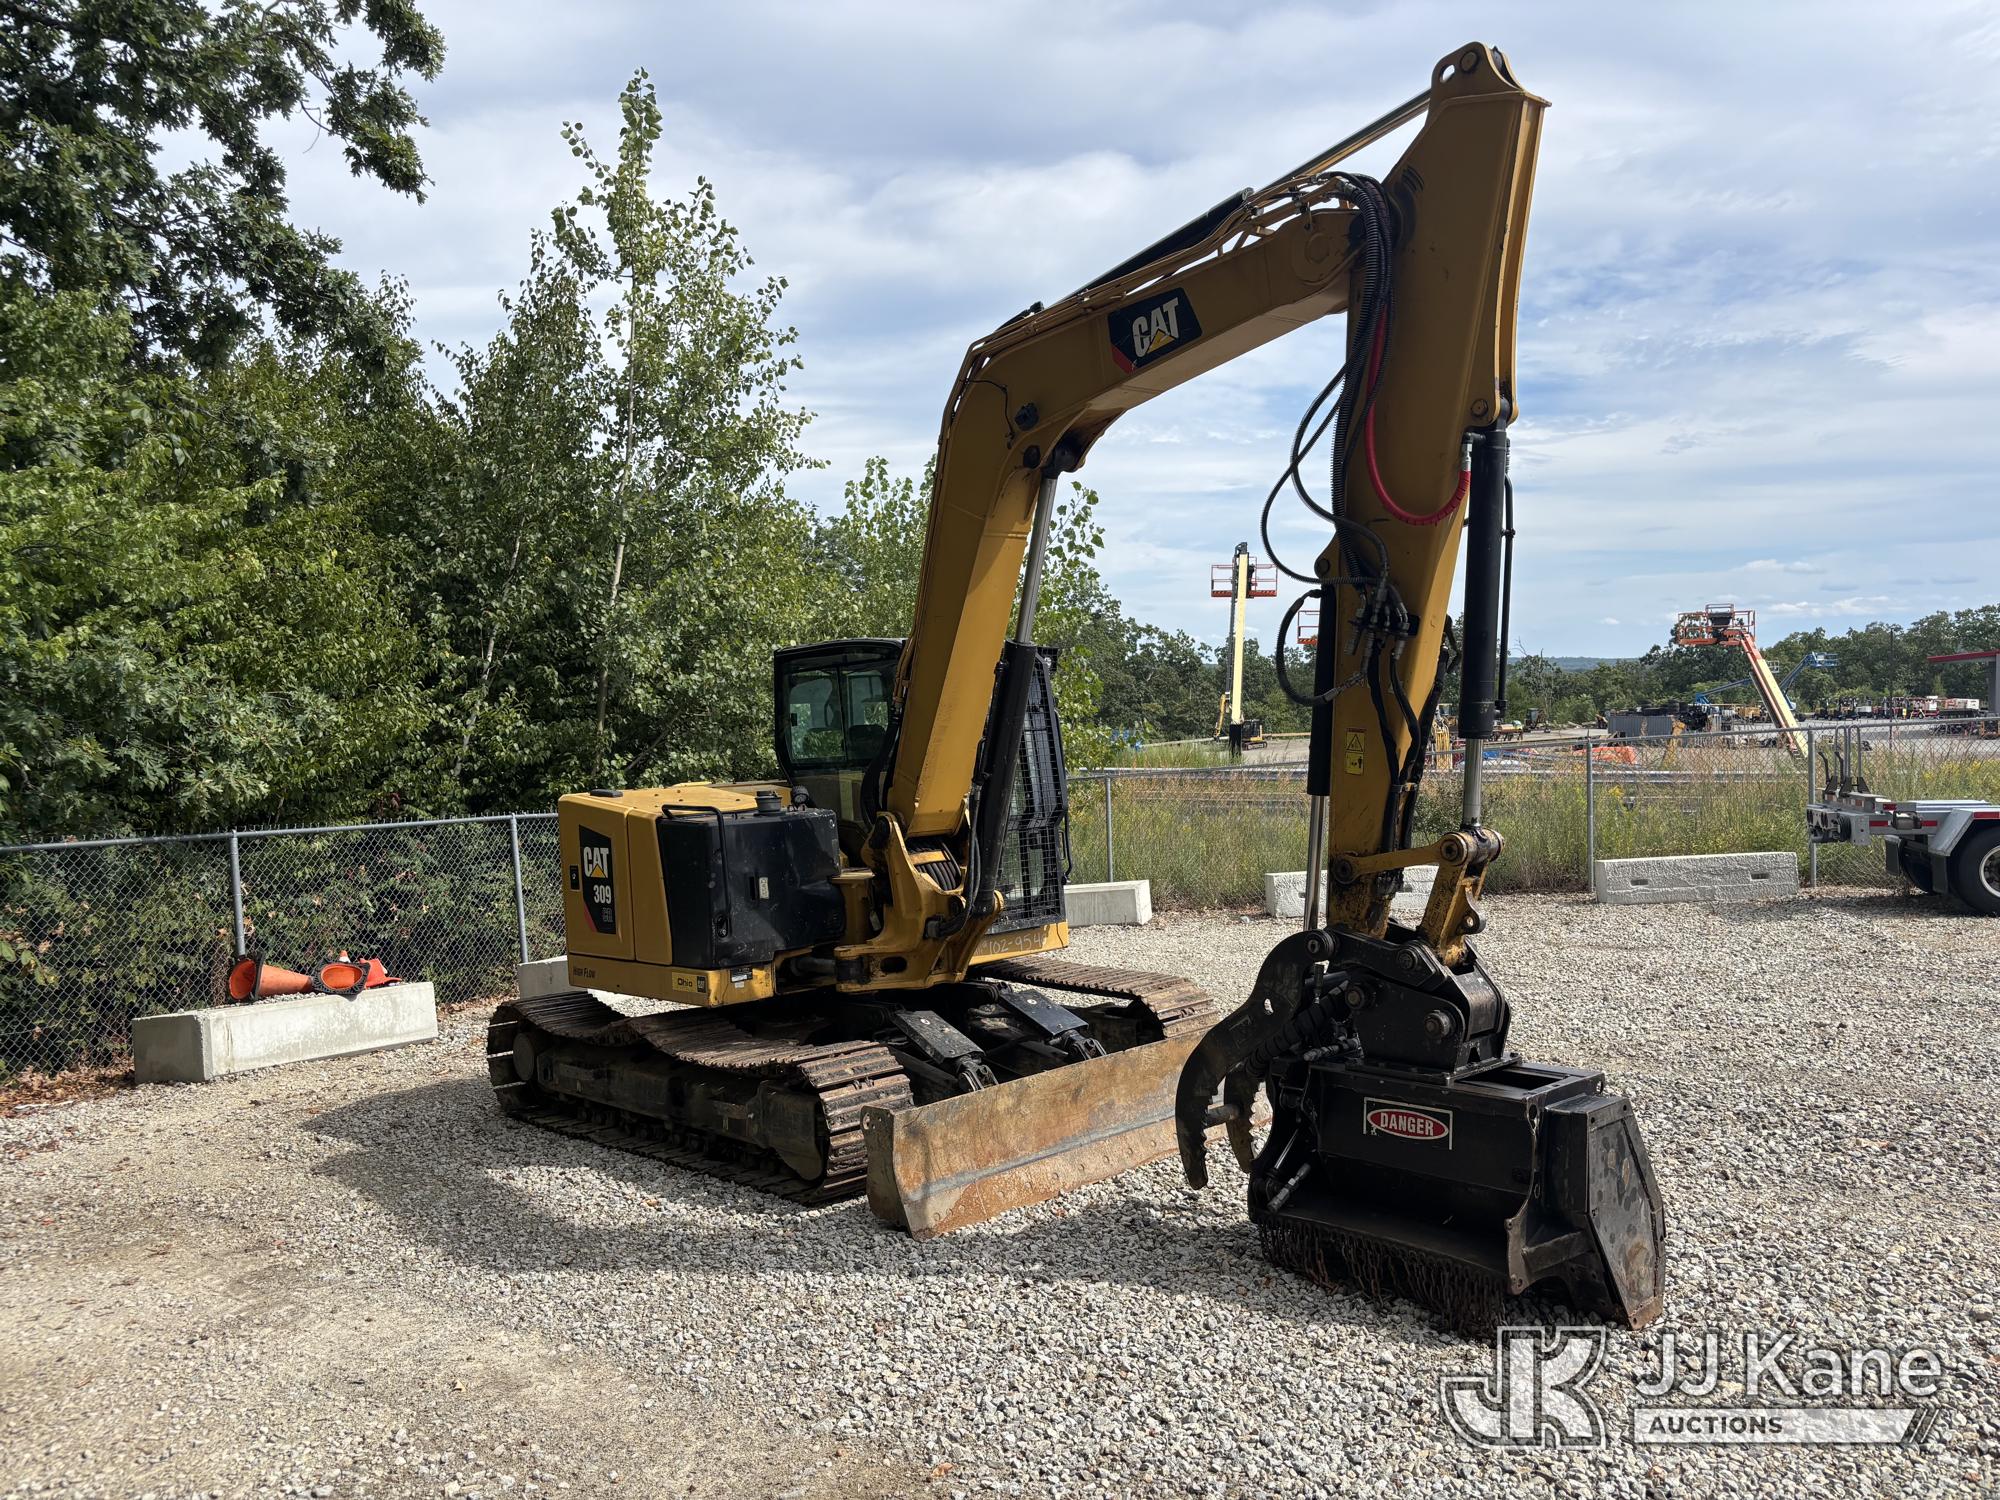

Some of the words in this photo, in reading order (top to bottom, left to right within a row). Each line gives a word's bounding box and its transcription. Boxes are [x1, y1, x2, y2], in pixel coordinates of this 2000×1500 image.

[1132, 297, 1179, 357] CAT
[583, 846, 609, 878] CAT
[593, 884, 611, 904] 309
[678, 977, 693, 988] Ohio
[1380, 1112, 1434, 1136] DANGER
